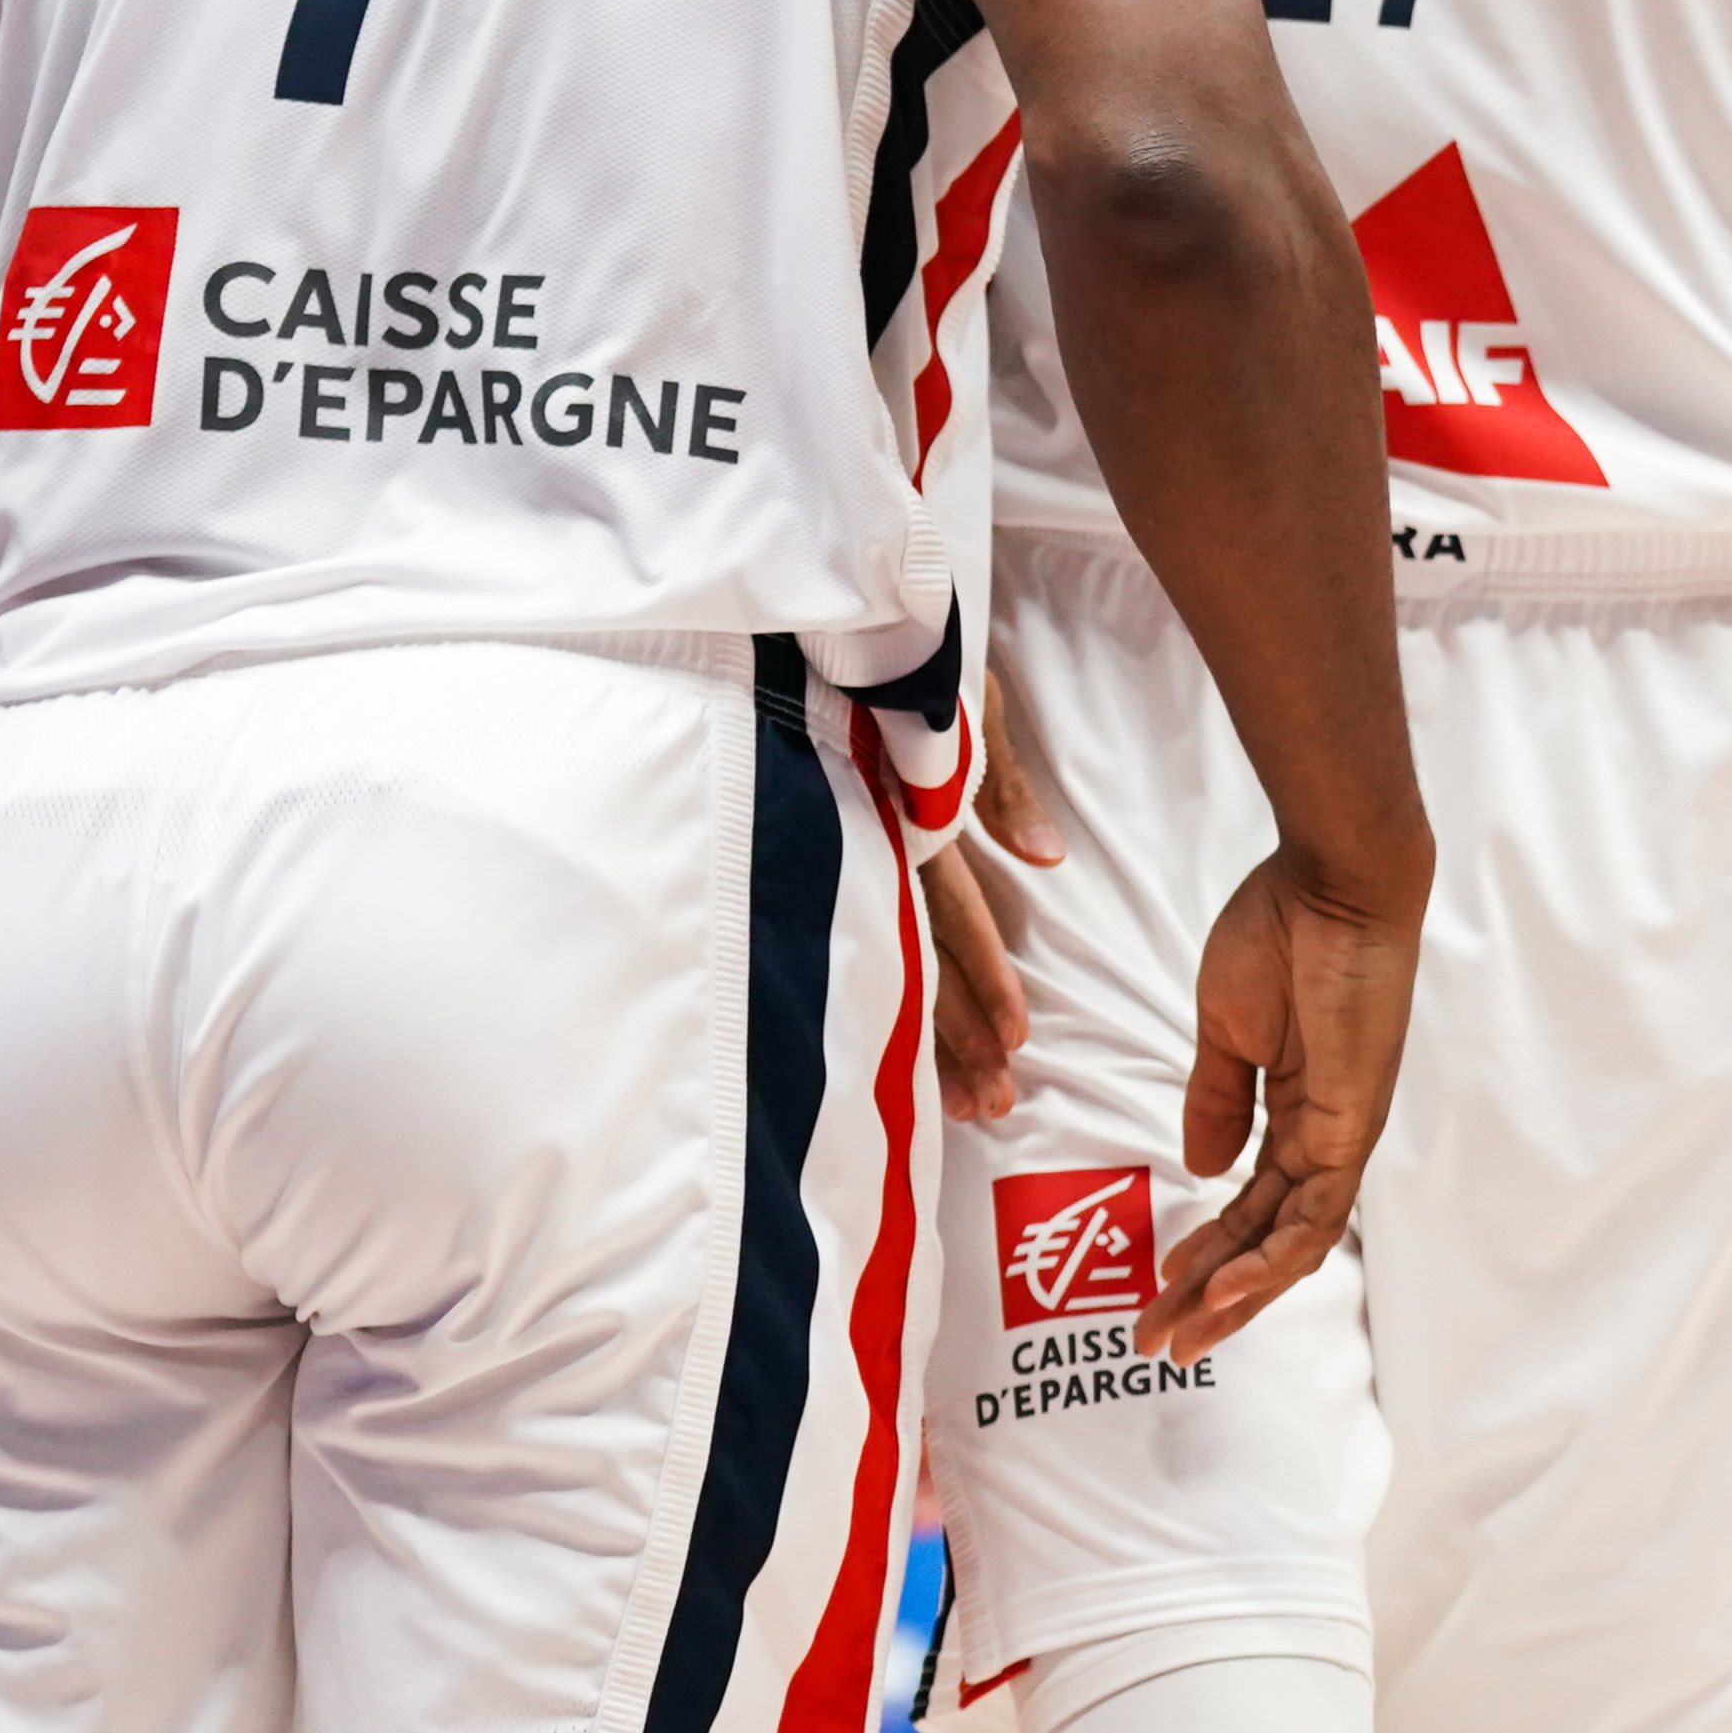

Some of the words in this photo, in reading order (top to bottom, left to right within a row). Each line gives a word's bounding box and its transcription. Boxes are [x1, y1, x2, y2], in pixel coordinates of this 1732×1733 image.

[202, 261, 546, 351] CAISSE
[1374, 314, 1526, 407] AIF
[200, 355, 748, 465] D'EPARGNE
[975, 1356, 1217, 1429] D'EPARGNE
[1011, 1325, 1140, 1376] CAISS
